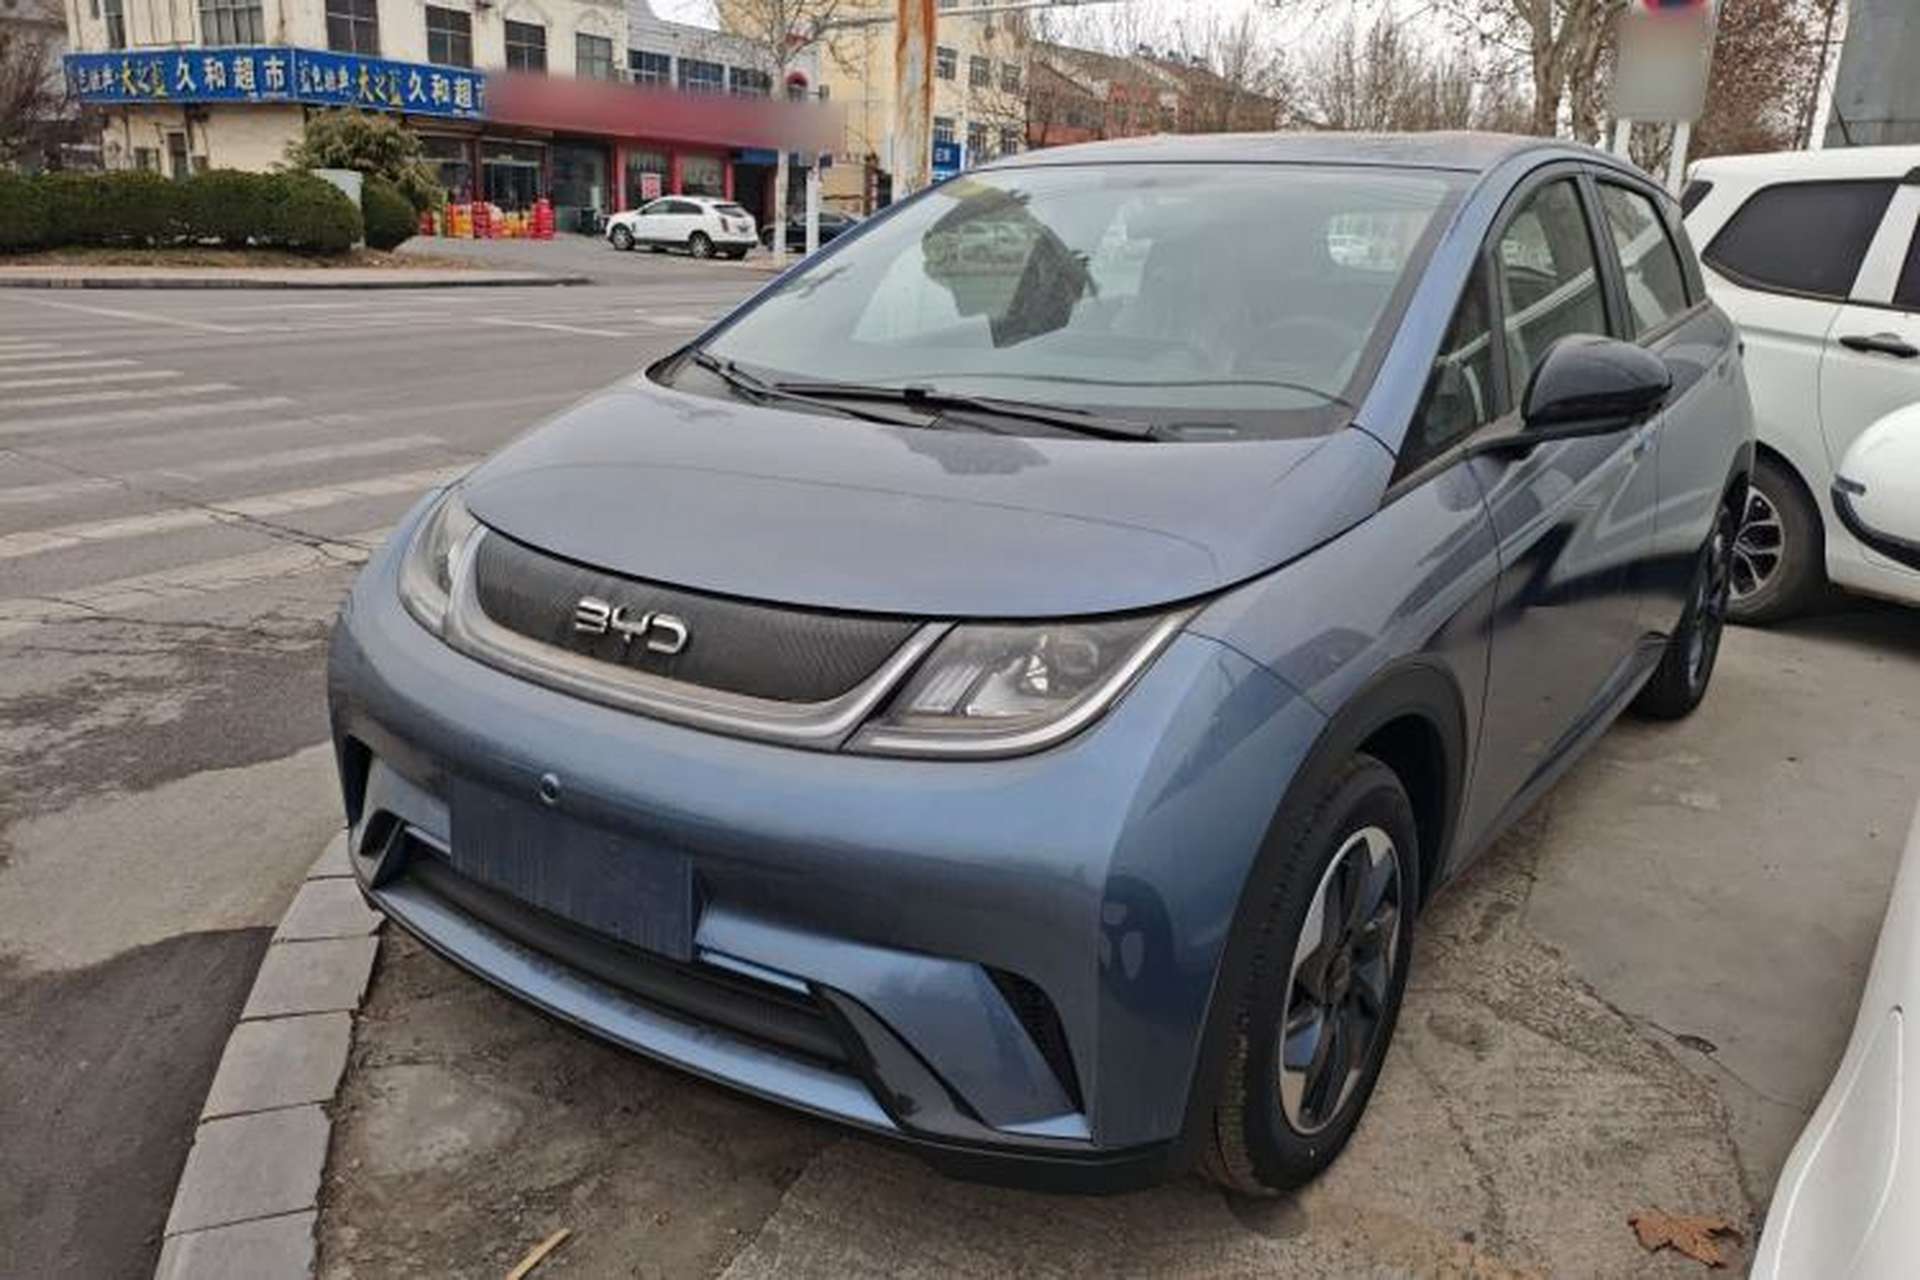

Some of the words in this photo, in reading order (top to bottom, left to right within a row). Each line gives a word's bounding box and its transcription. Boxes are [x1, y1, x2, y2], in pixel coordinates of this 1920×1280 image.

[176, 55, 285, 91] 久和超市
[575, 596, 688, 654] BYD
